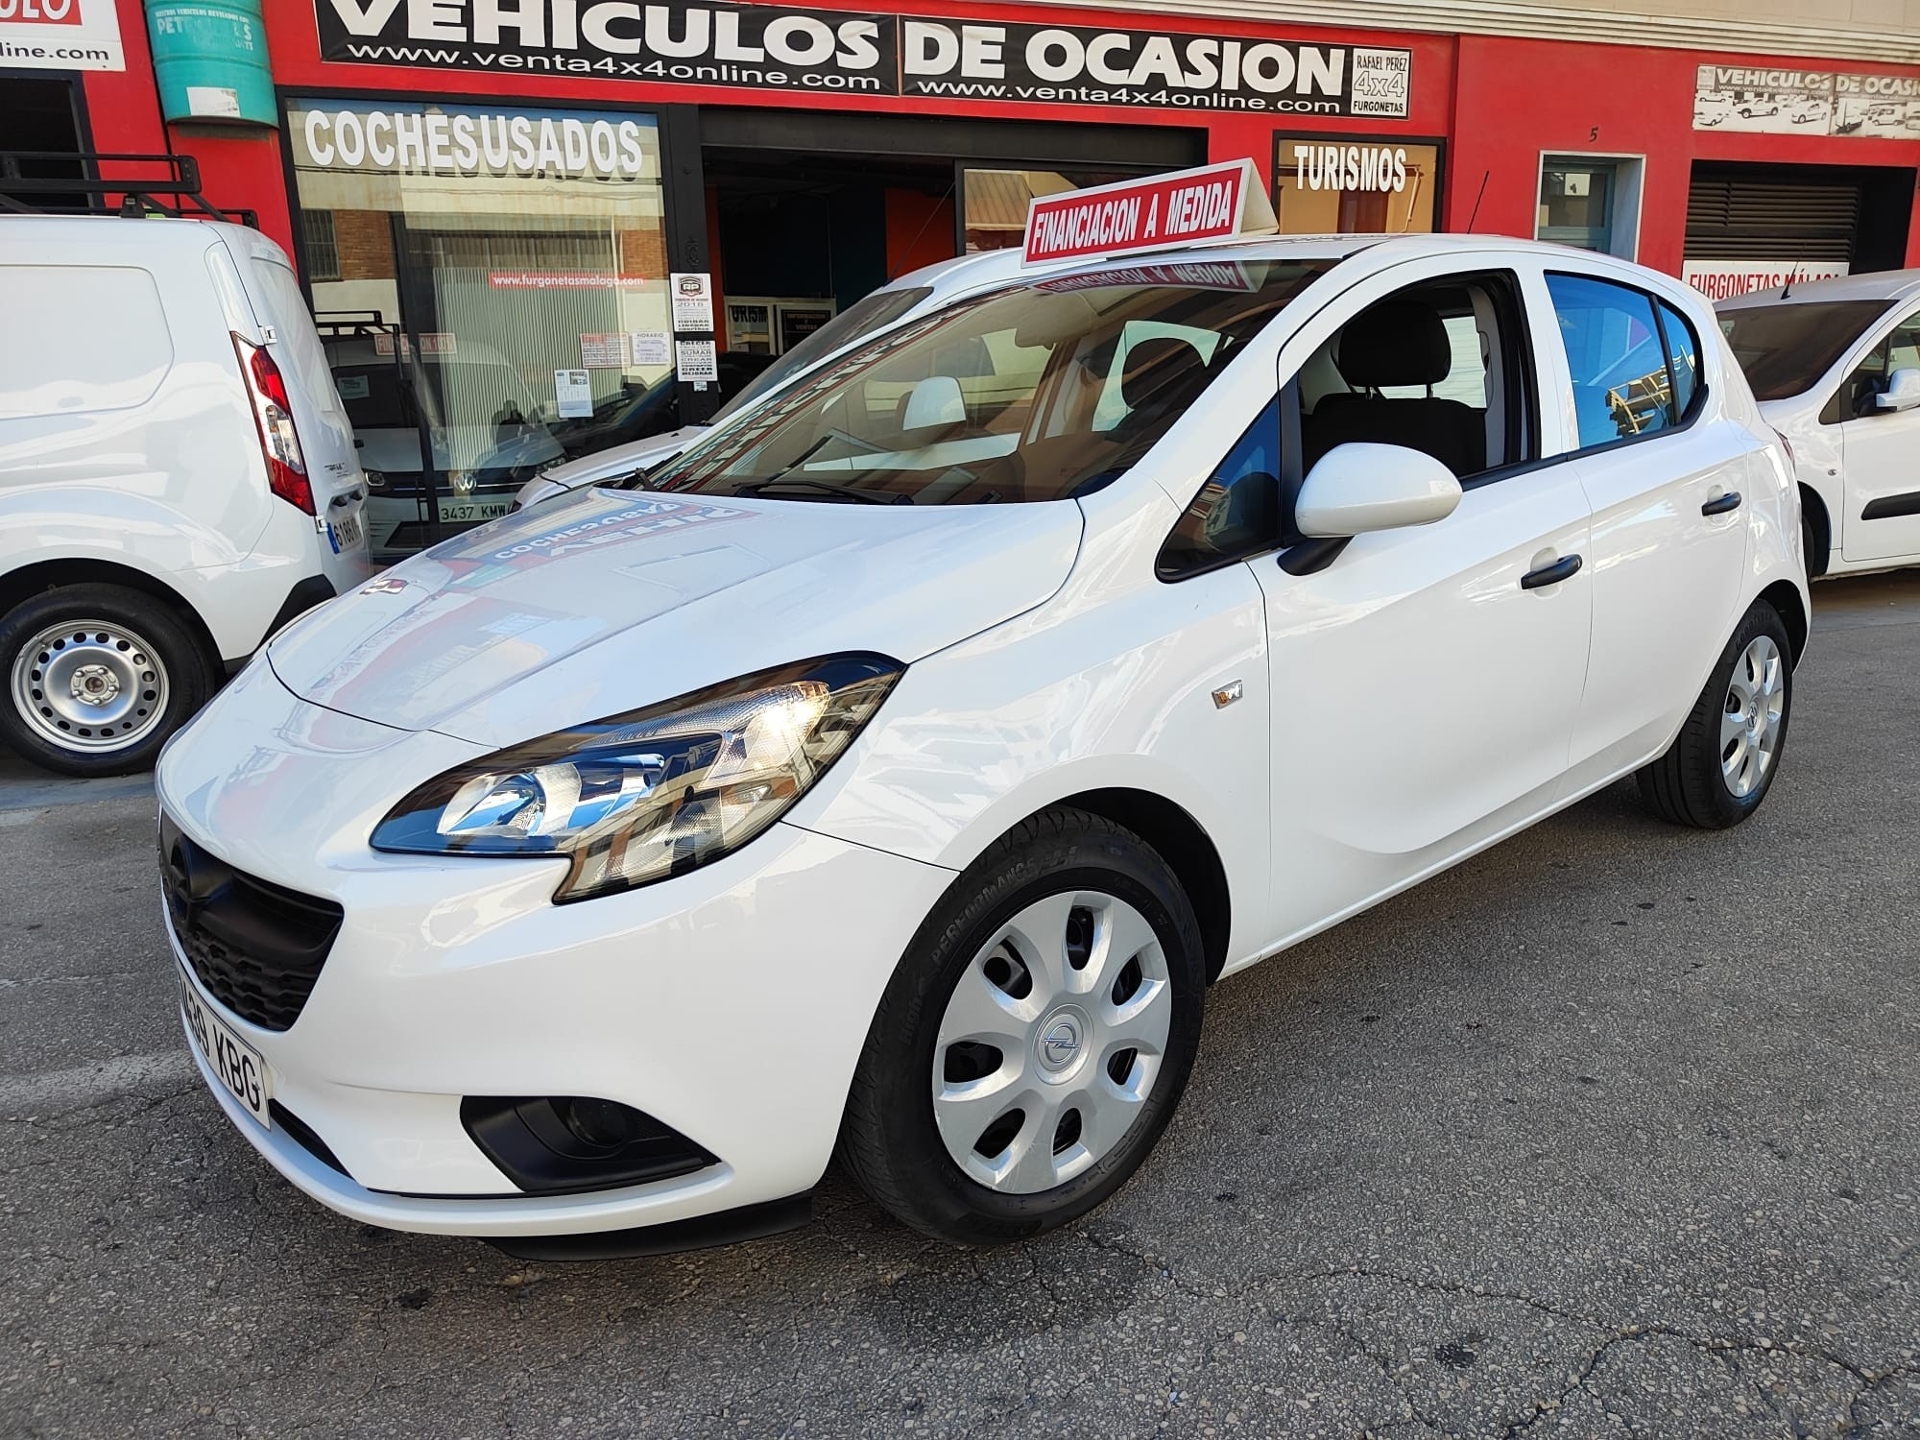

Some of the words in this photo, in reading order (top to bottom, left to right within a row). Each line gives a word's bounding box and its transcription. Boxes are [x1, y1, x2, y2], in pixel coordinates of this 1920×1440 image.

[328, 0, 880, 69] VEHICULOS
[347, 44, 880, 90] www.venta4x4online.com
[904, 22, 1006, 79] DE
[1025, 30, 1345, 97] OCASION
[1356, 55, 1383, 70] RAFAEL
[1386, 56, 1407, 71] PEREZ
[917, 80, 1340, 114] www.venta4x4online.com
[1354, 70, 1405, 97] 4x4
[1716, 68, 1832, 90] VEHICULOS
[1835, 75, 1861, 92] DE
[1353, 101, 1403, 112] FURGONETAS
[1588, 127, 1599, 143] 5
[1295, 145, 1406, 193] TURISMOS
[1031, 197, 1140, 256] FINANCIACION
[1144, 204, 1158, 236] A
[1166, 179, 1232, 234] MEDIDA
[441, 506, 474, 520] 3437
[212, 1023, 261, 1112] KBG
